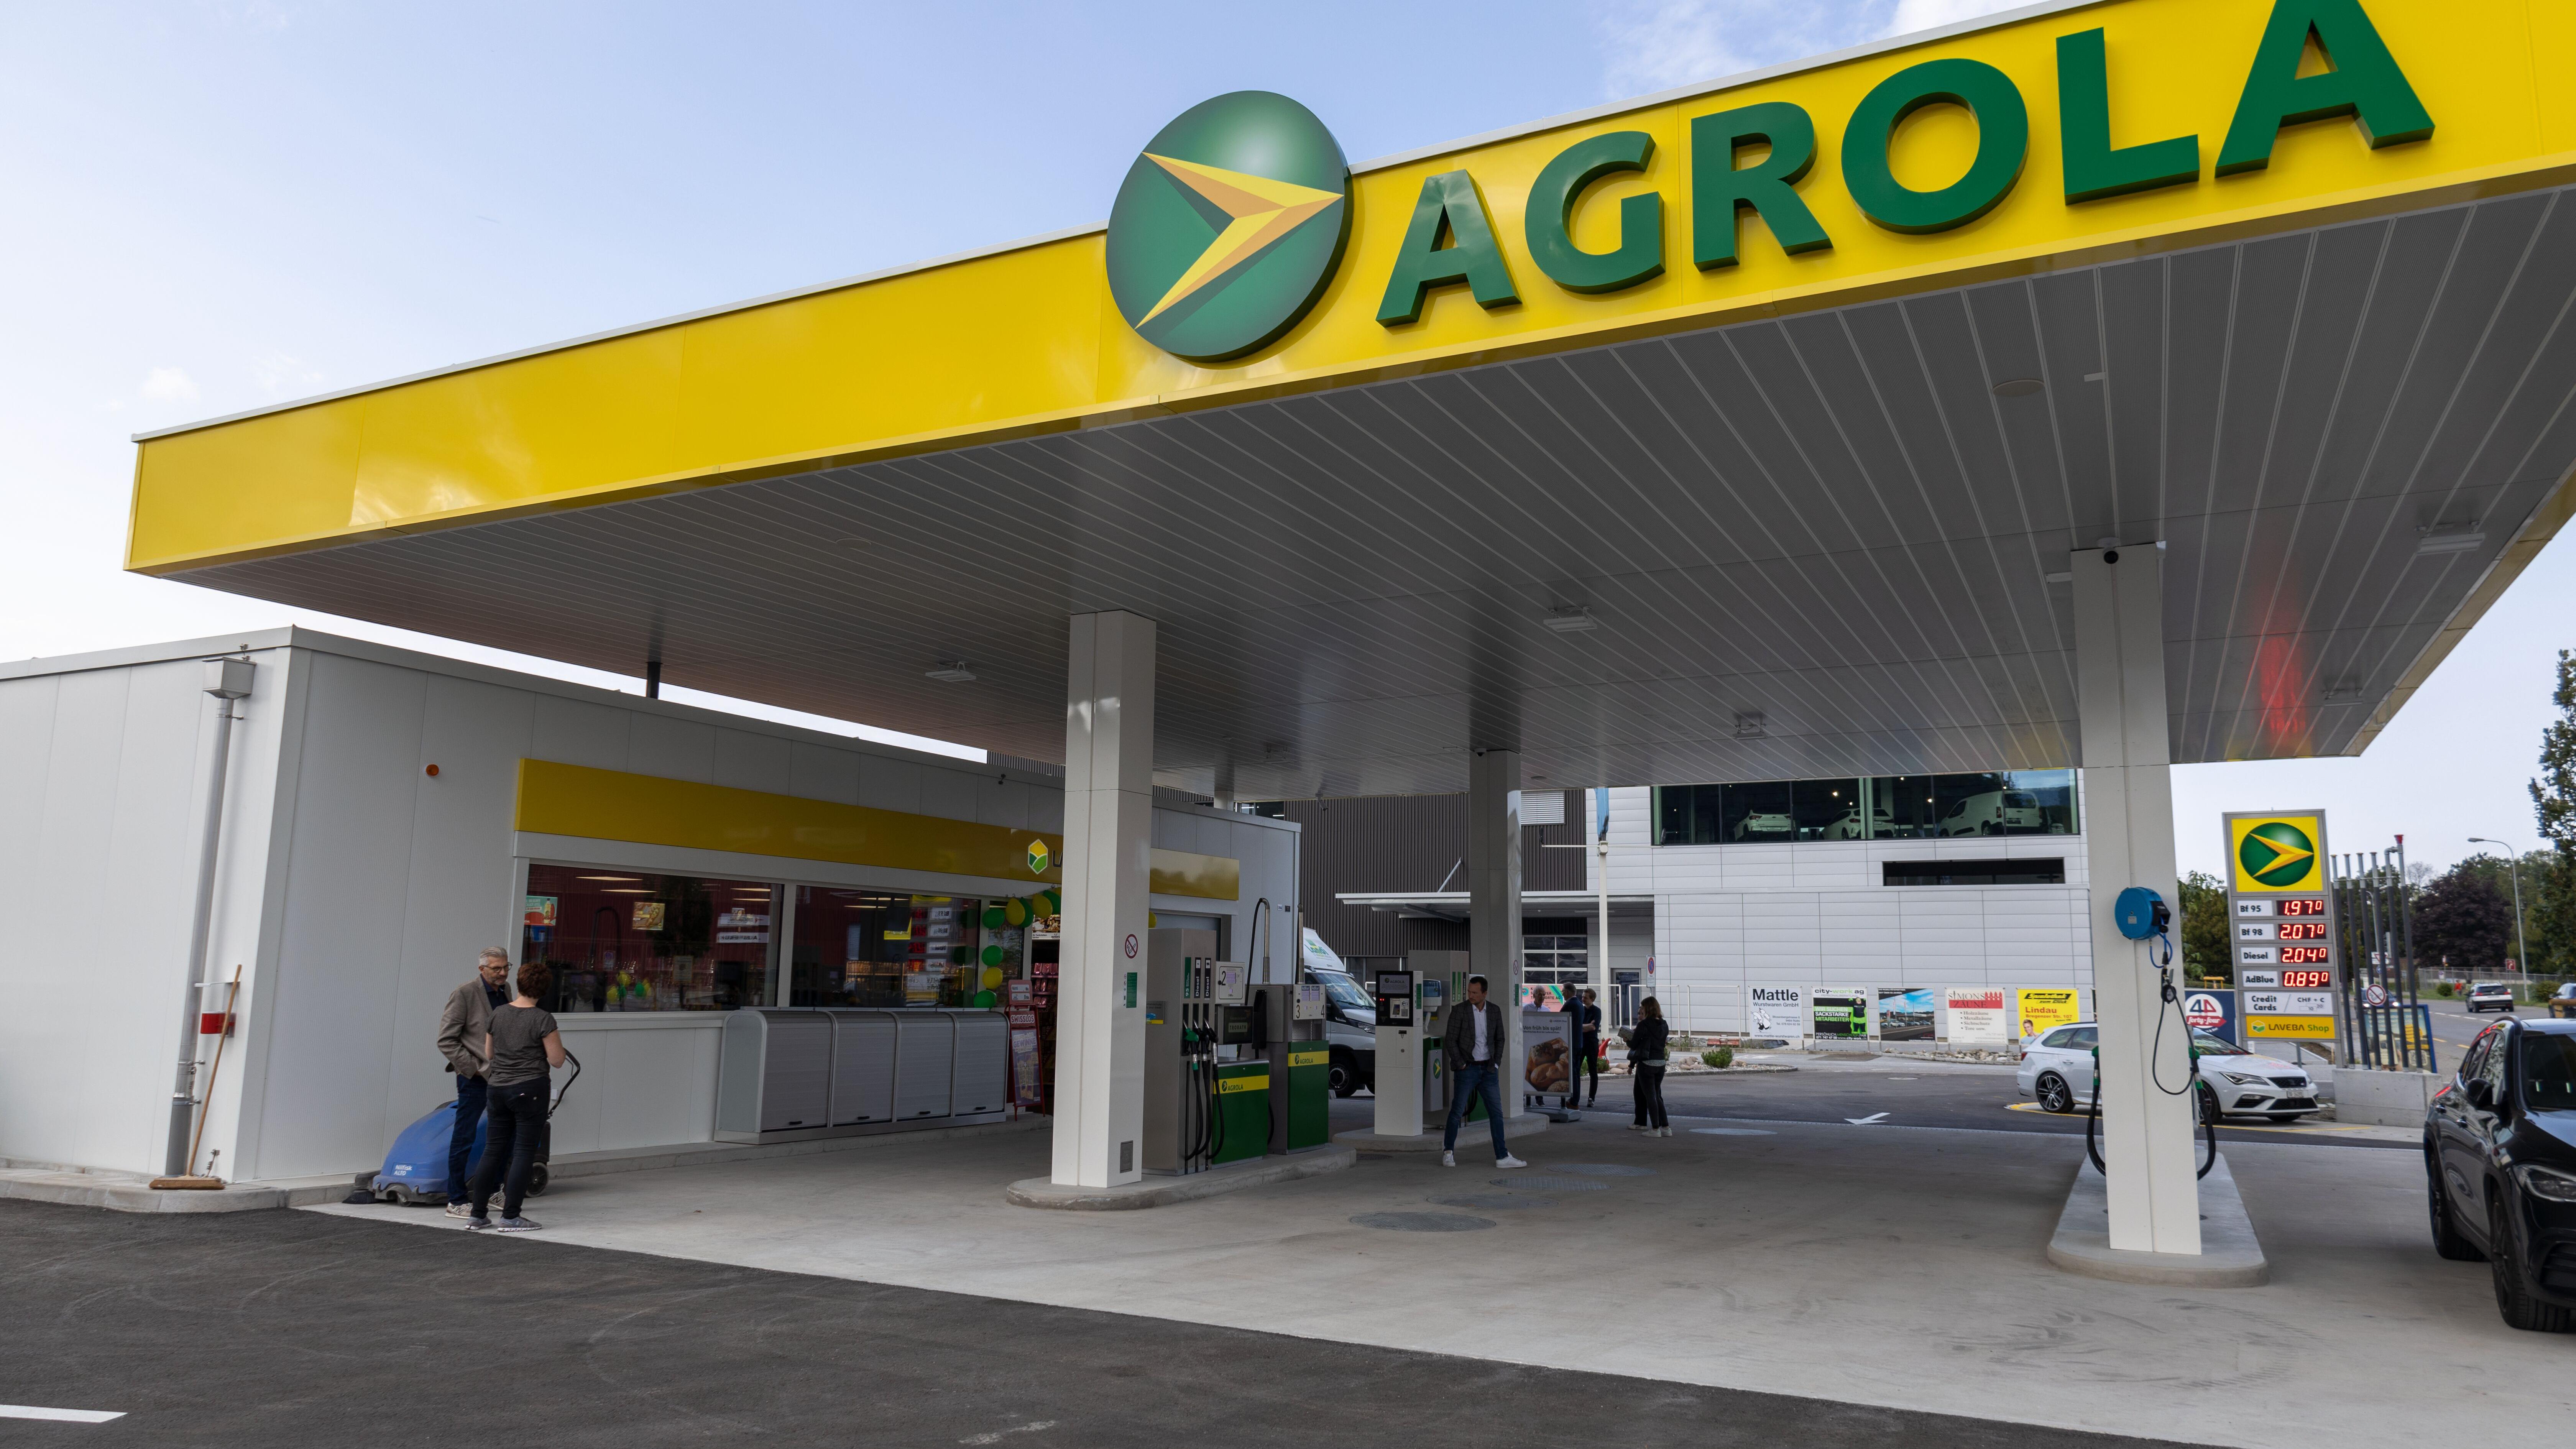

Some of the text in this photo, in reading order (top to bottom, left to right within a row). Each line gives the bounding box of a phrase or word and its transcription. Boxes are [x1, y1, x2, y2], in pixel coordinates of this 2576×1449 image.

[1375, 0, 2436, 329] AGROLA
[1221, 971, 1226, 986] 2
[1186, 988, 1189, 996] 95
[1753, 989, 1798, 1001] Mattle
[1948, 991, 1985, 1000] SIMONS
[1296, 1004, 1300, 1019] 3
[1321, 1004, 1324, 1018] 4
[1011, 1014, 1034, 1023] SWISSLOS
[2308, 1024, 2329, 1033] Shop
[1013, 1037, 1036, 1048] GEWINNE
